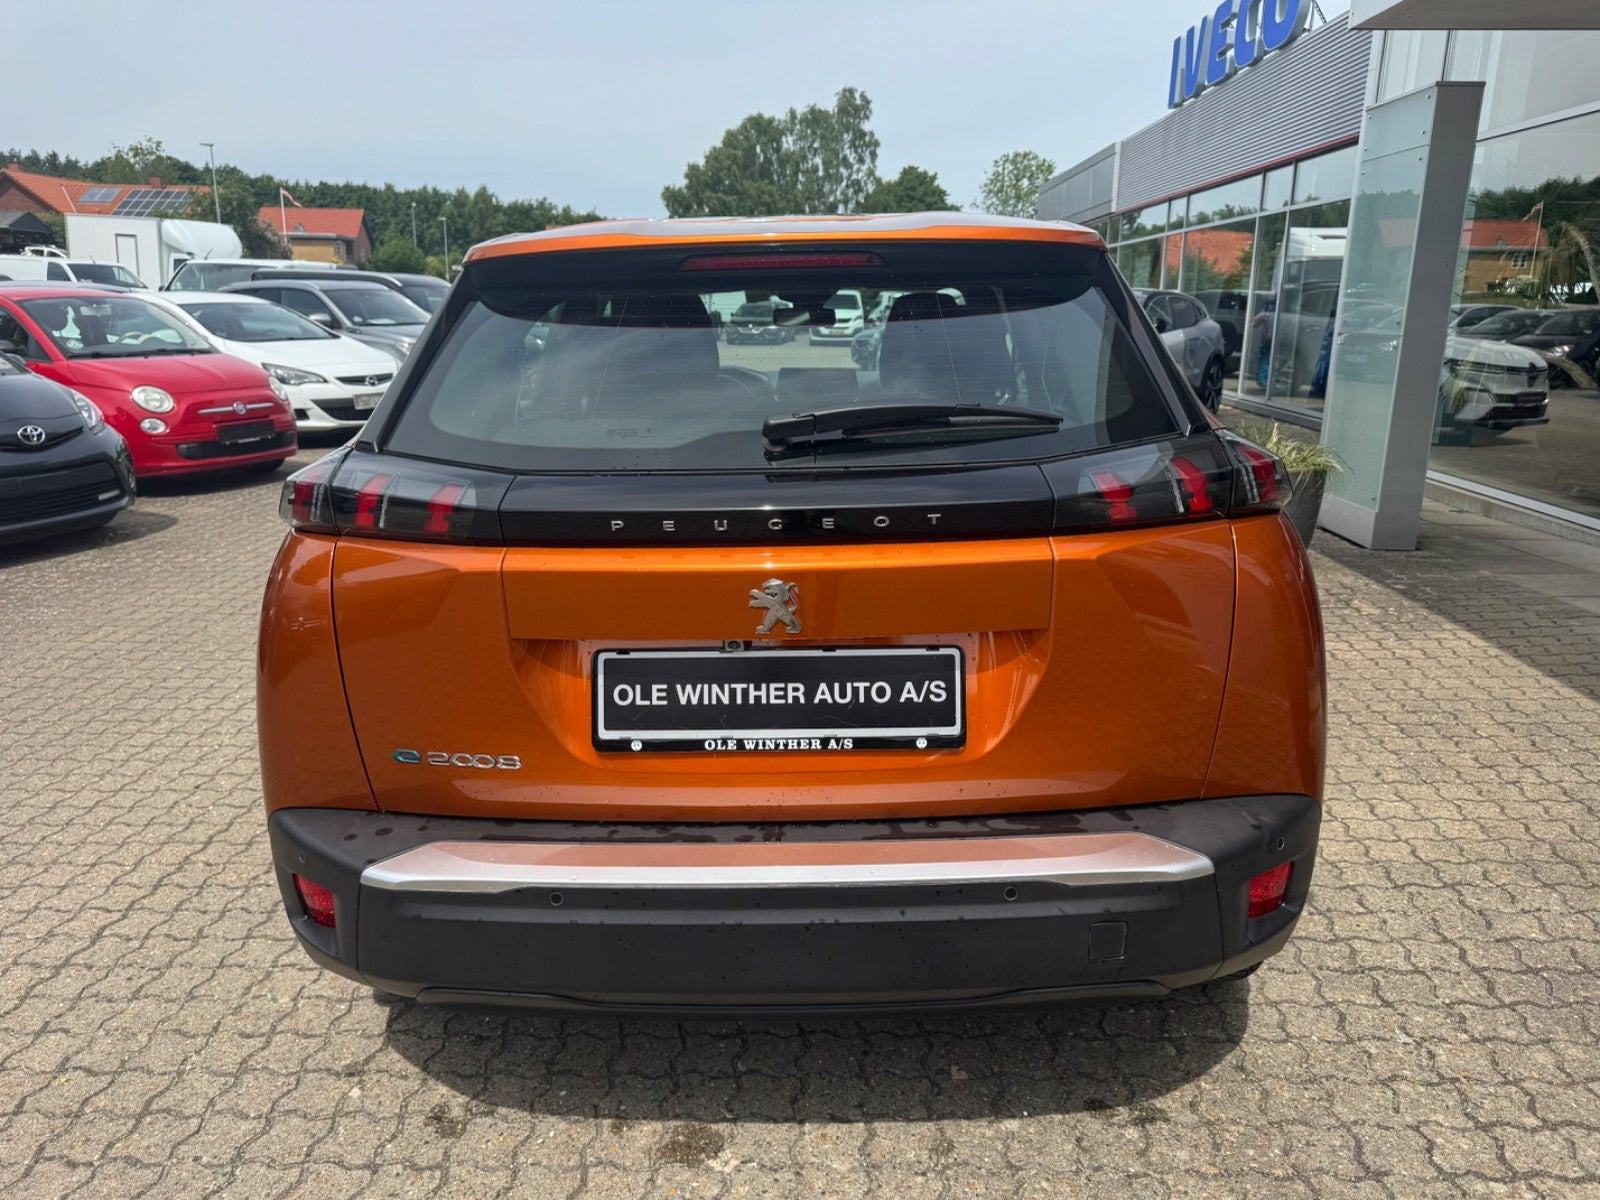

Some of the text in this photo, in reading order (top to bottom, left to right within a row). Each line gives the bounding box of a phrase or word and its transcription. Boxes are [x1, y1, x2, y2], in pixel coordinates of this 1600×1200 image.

[610, 512, 943, 532] PEUGEOT
[612, 680, 948, 707] OLE WINTHER AUTO A/S
[704, 738, 854, 751] OLE WINTHER A/S
